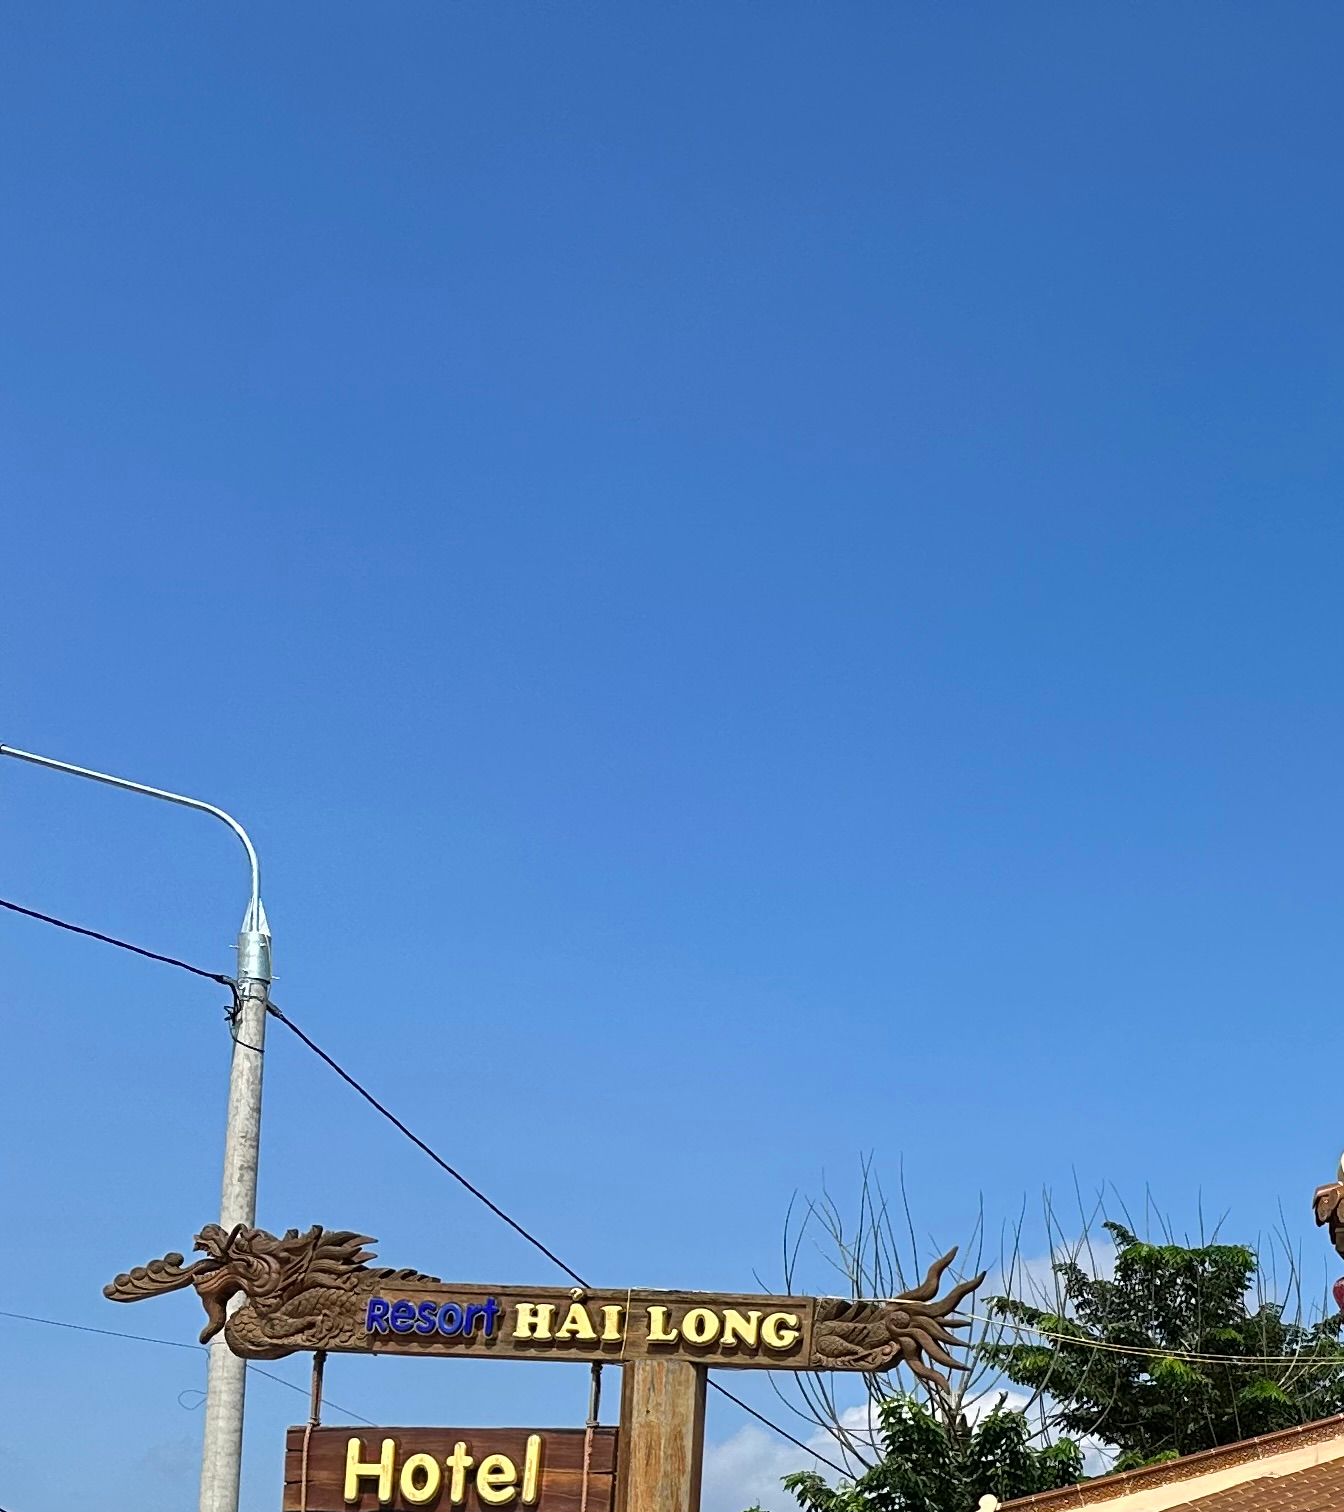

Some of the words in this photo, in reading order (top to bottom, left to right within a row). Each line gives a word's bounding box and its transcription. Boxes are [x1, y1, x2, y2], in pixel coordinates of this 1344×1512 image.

[364, 1295, 500, 1340] Resort
[511, 1287, 625, 1343] HẢI
[645, 1304, 801, 1350] LONG
[343, 1434, 542, 1505] Hotel
